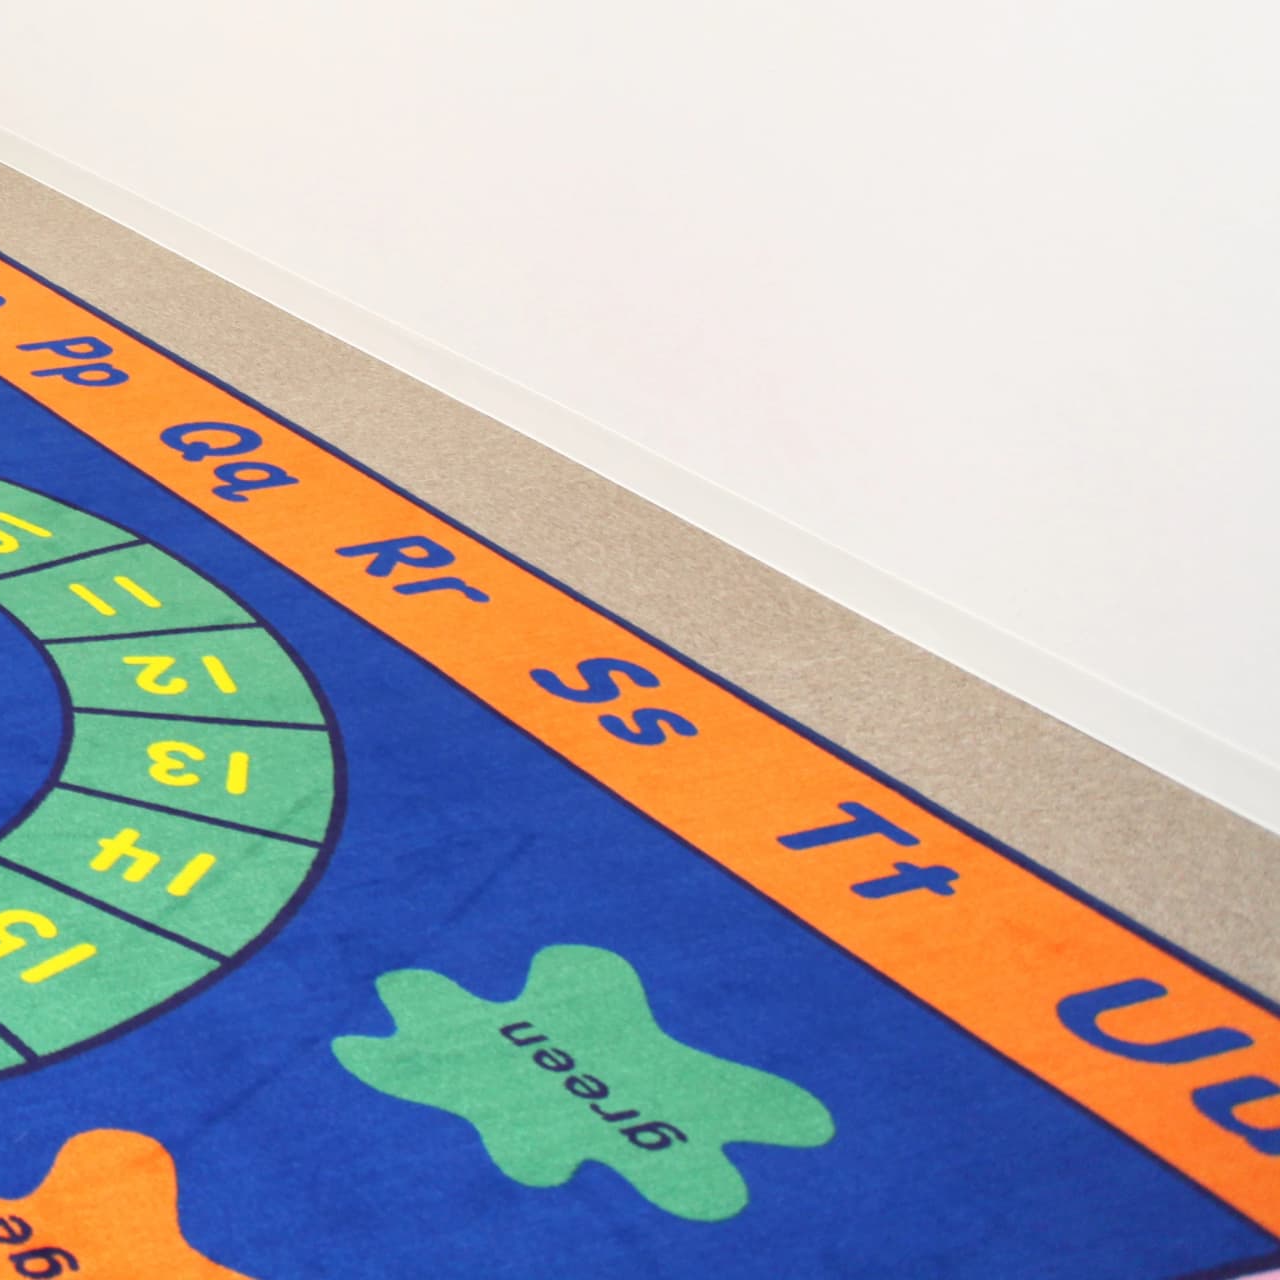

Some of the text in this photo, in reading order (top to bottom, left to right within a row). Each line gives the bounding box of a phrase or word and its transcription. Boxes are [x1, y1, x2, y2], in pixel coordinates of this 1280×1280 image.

[21, 338, 128, 385] Pp
[160, 422, 299, 501] Qq
[335, 536, 489, 602] Rr
[529, 657, 698, 746] Ss
[777, 801, 960, 899] Tt
[70, 577, 160, 615] 11
[124, 656, 236, 694] 12
[148, 741, 248, 794] 13
[91, 829, 215, 895] 14
[500, 1020, 688, 1151] green
